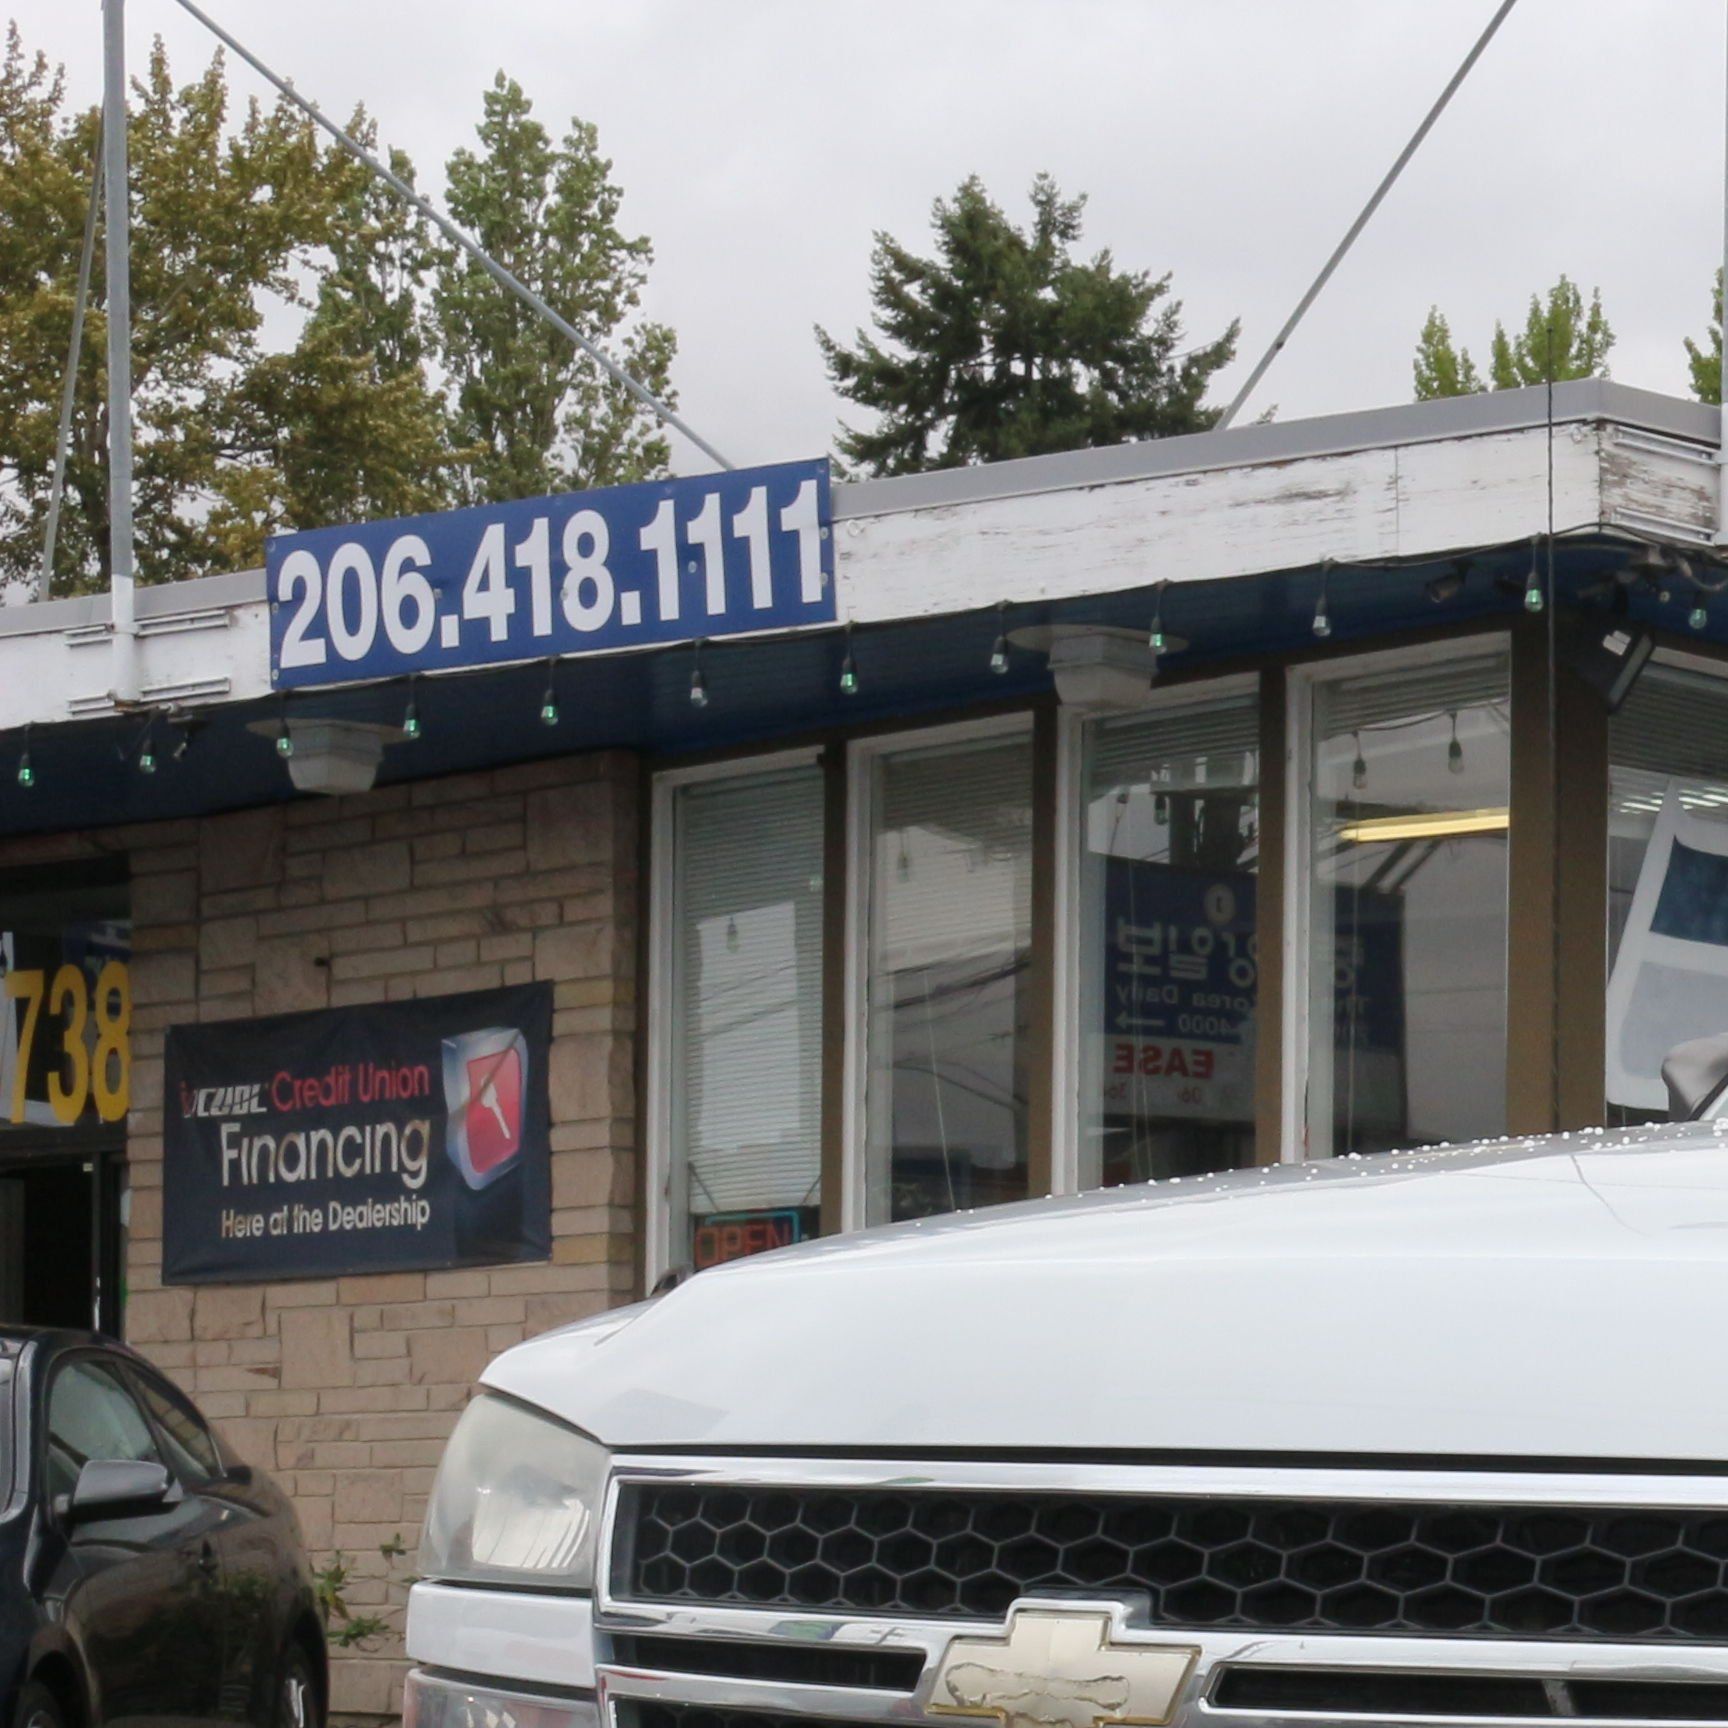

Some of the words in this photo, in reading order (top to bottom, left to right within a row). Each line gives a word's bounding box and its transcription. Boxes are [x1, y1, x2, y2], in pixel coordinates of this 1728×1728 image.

[277, 478, 823, 669] 206.418.1111
[272, 1065, 351, 1112] Credit
[357, 1061, 431, 1103] Union
[220, 1119, 431, 1189] Financing
[221, 1209, 265, 1238] Here
[269, 1205, 288, 1236] at
[293, 1203, 323, 1234] the
[328, 1194, 431, 1231] Dealership
